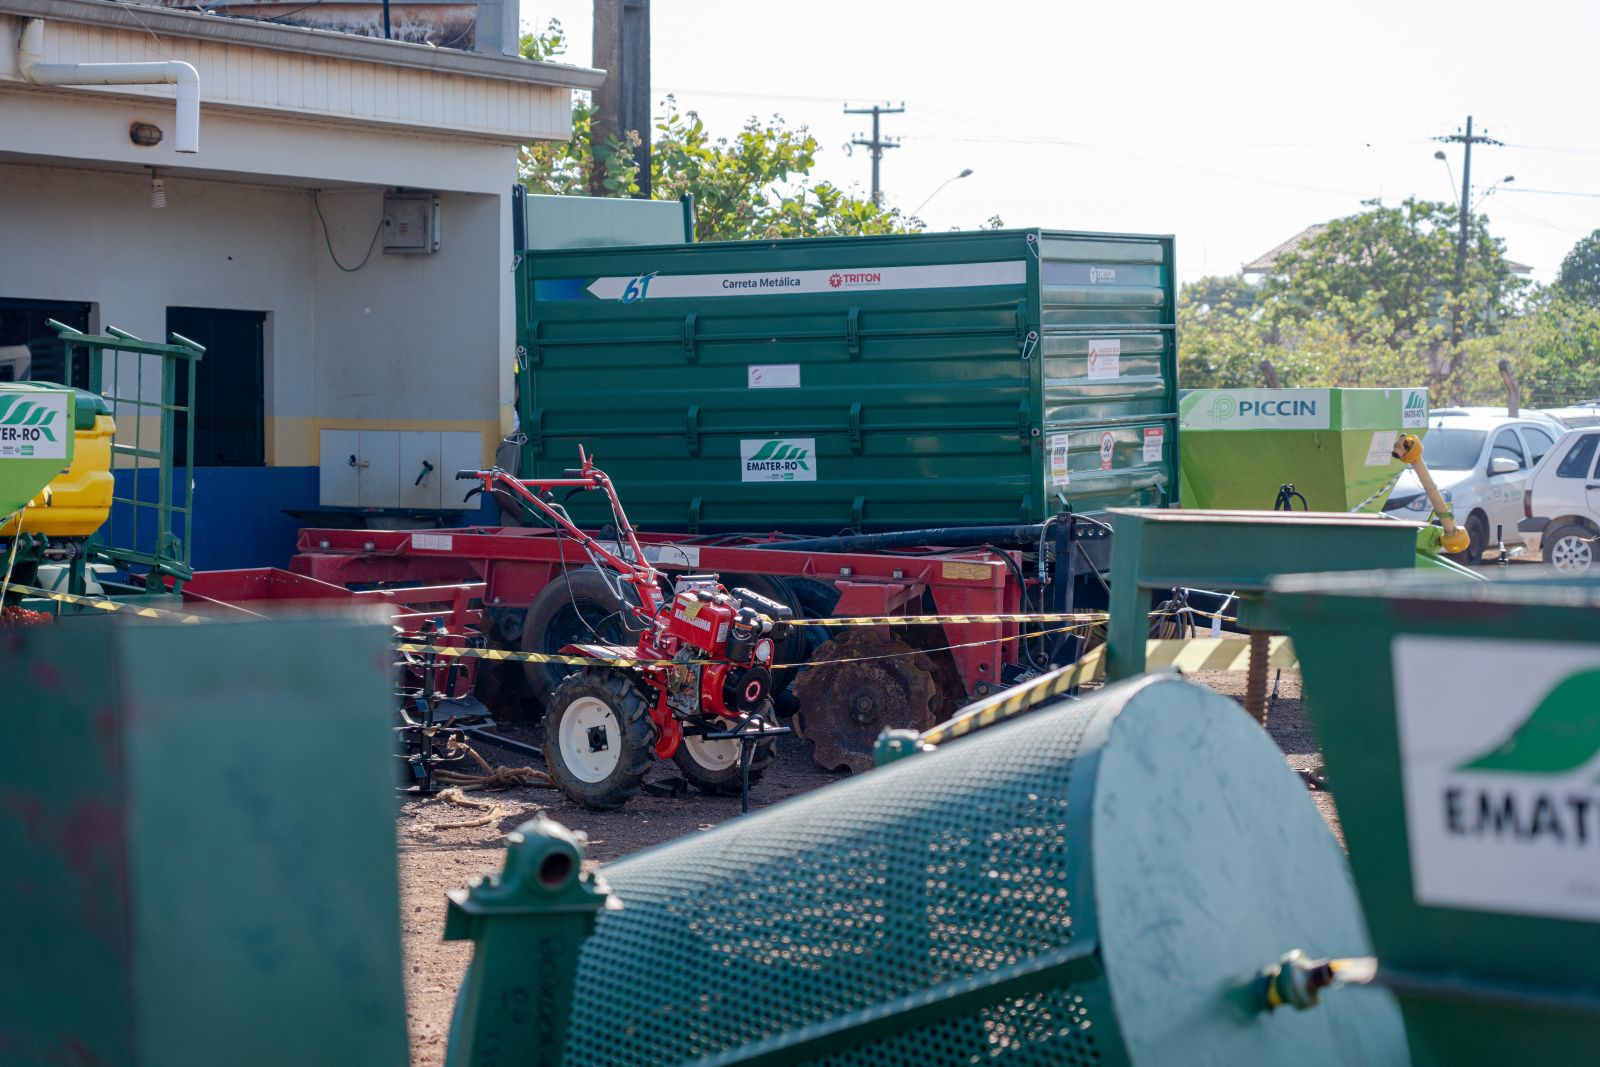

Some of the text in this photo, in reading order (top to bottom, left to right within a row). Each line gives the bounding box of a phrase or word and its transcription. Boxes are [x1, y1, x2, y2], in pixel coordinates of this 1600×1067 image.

[843, 273, 881, 283] TRITON
[1096, 269, 1116, 279] TRITON
[622, 271, 658, 304] 6T
[722, 277, 801, 289] Carreta Metálica
[1239, 400, 1316, 417] PICCIN
[0, 427, 40, 441] ER-RO
[746, 461, 798, 471] EMATER-RO
[1443, 785, 1600, 846] EMAT
